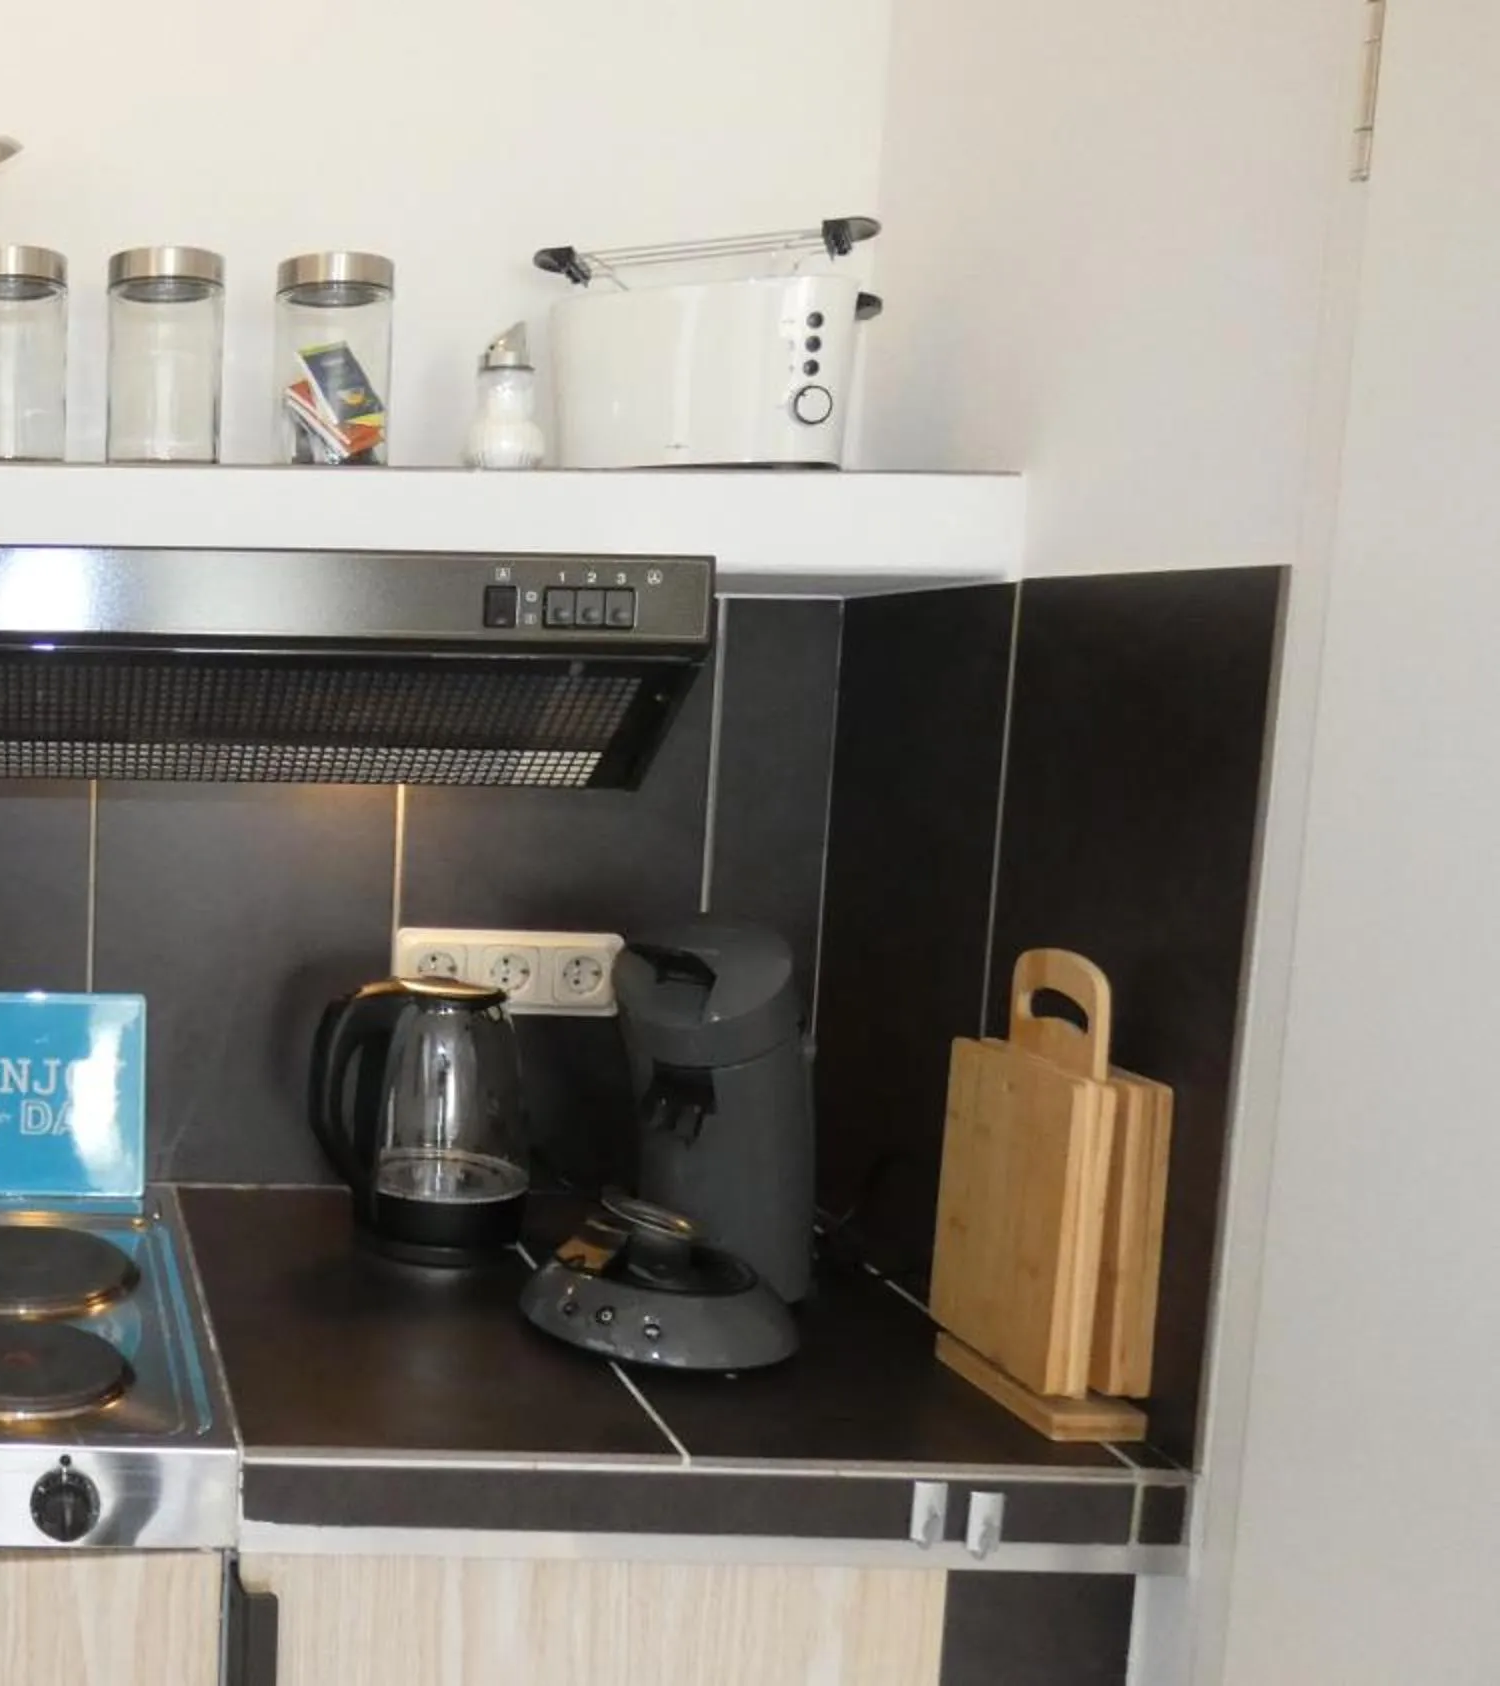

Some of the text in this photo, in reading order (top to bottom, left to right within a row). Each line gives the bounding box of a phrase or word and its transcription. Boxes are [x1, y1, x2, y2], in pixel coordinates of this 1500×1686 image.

[558, 571, 628, 585] 1 2 3
